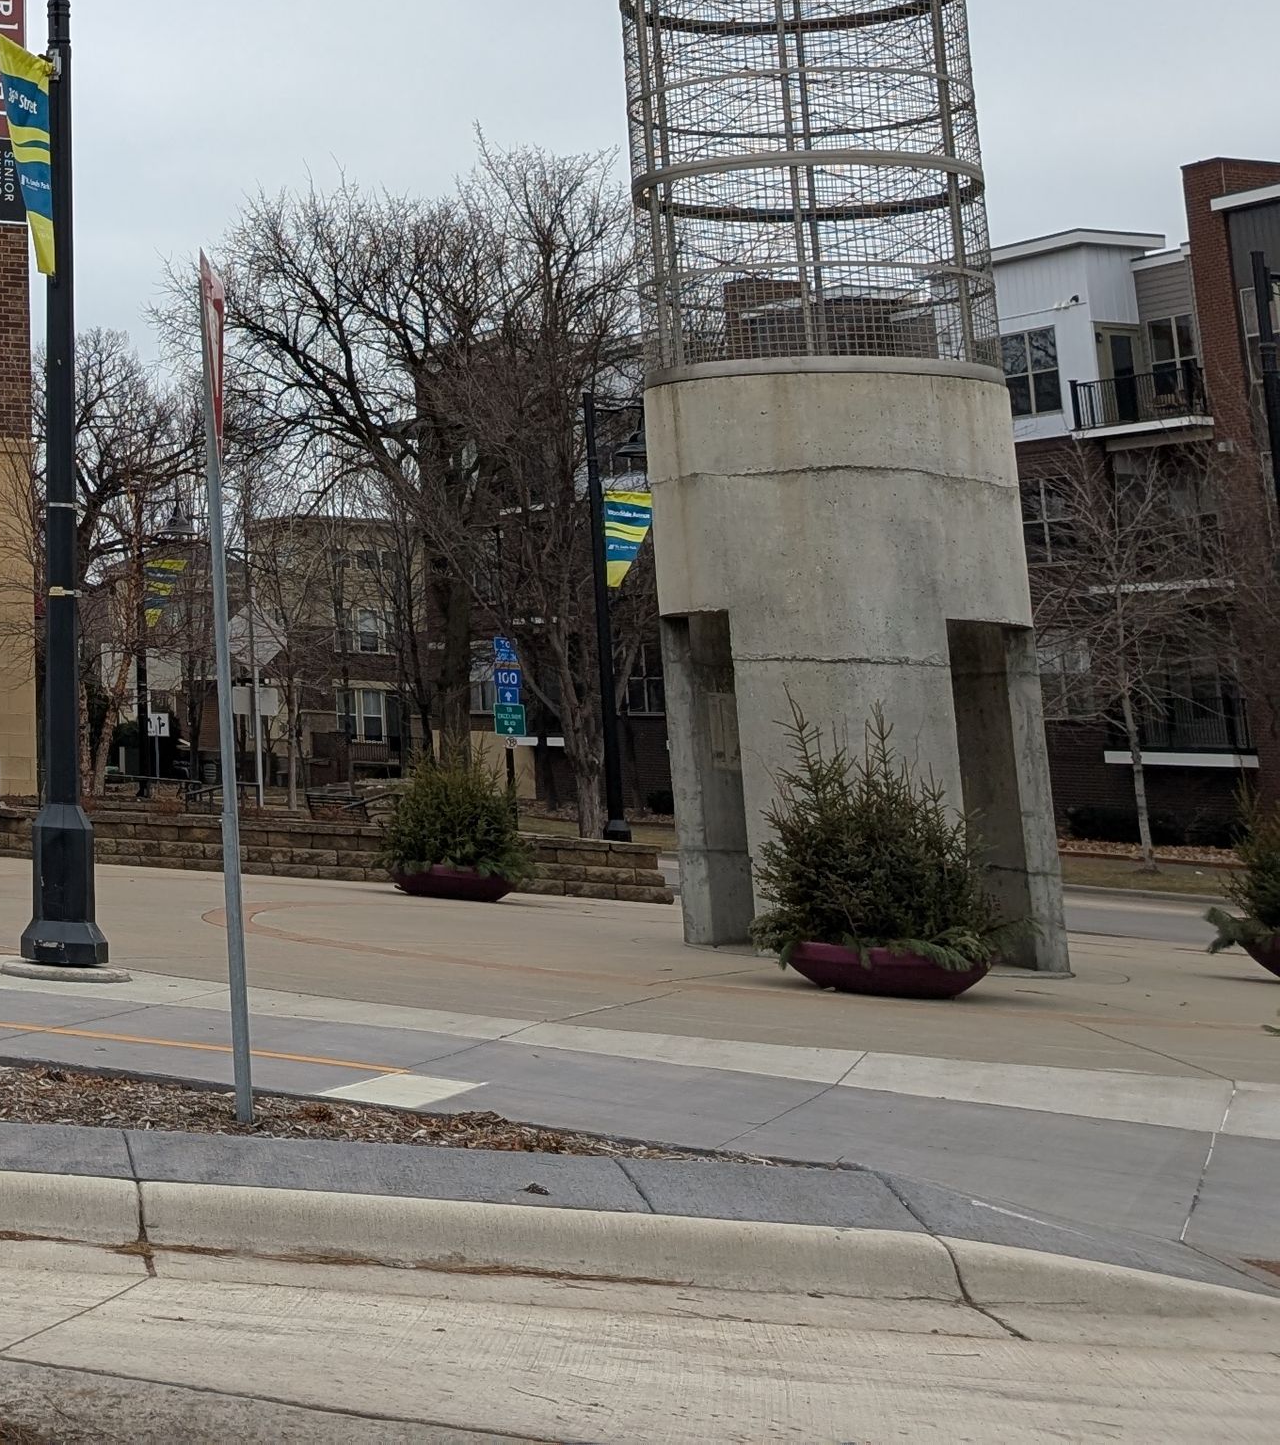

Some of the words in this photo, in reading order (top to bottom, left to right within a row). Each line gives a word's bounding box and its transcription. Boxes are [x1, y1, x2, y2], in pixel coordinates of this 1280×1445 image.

[4, 150, 15, 202] SENIOR
[500, 640, 511, 649] TO
[497, 671, 518, 685] 100
